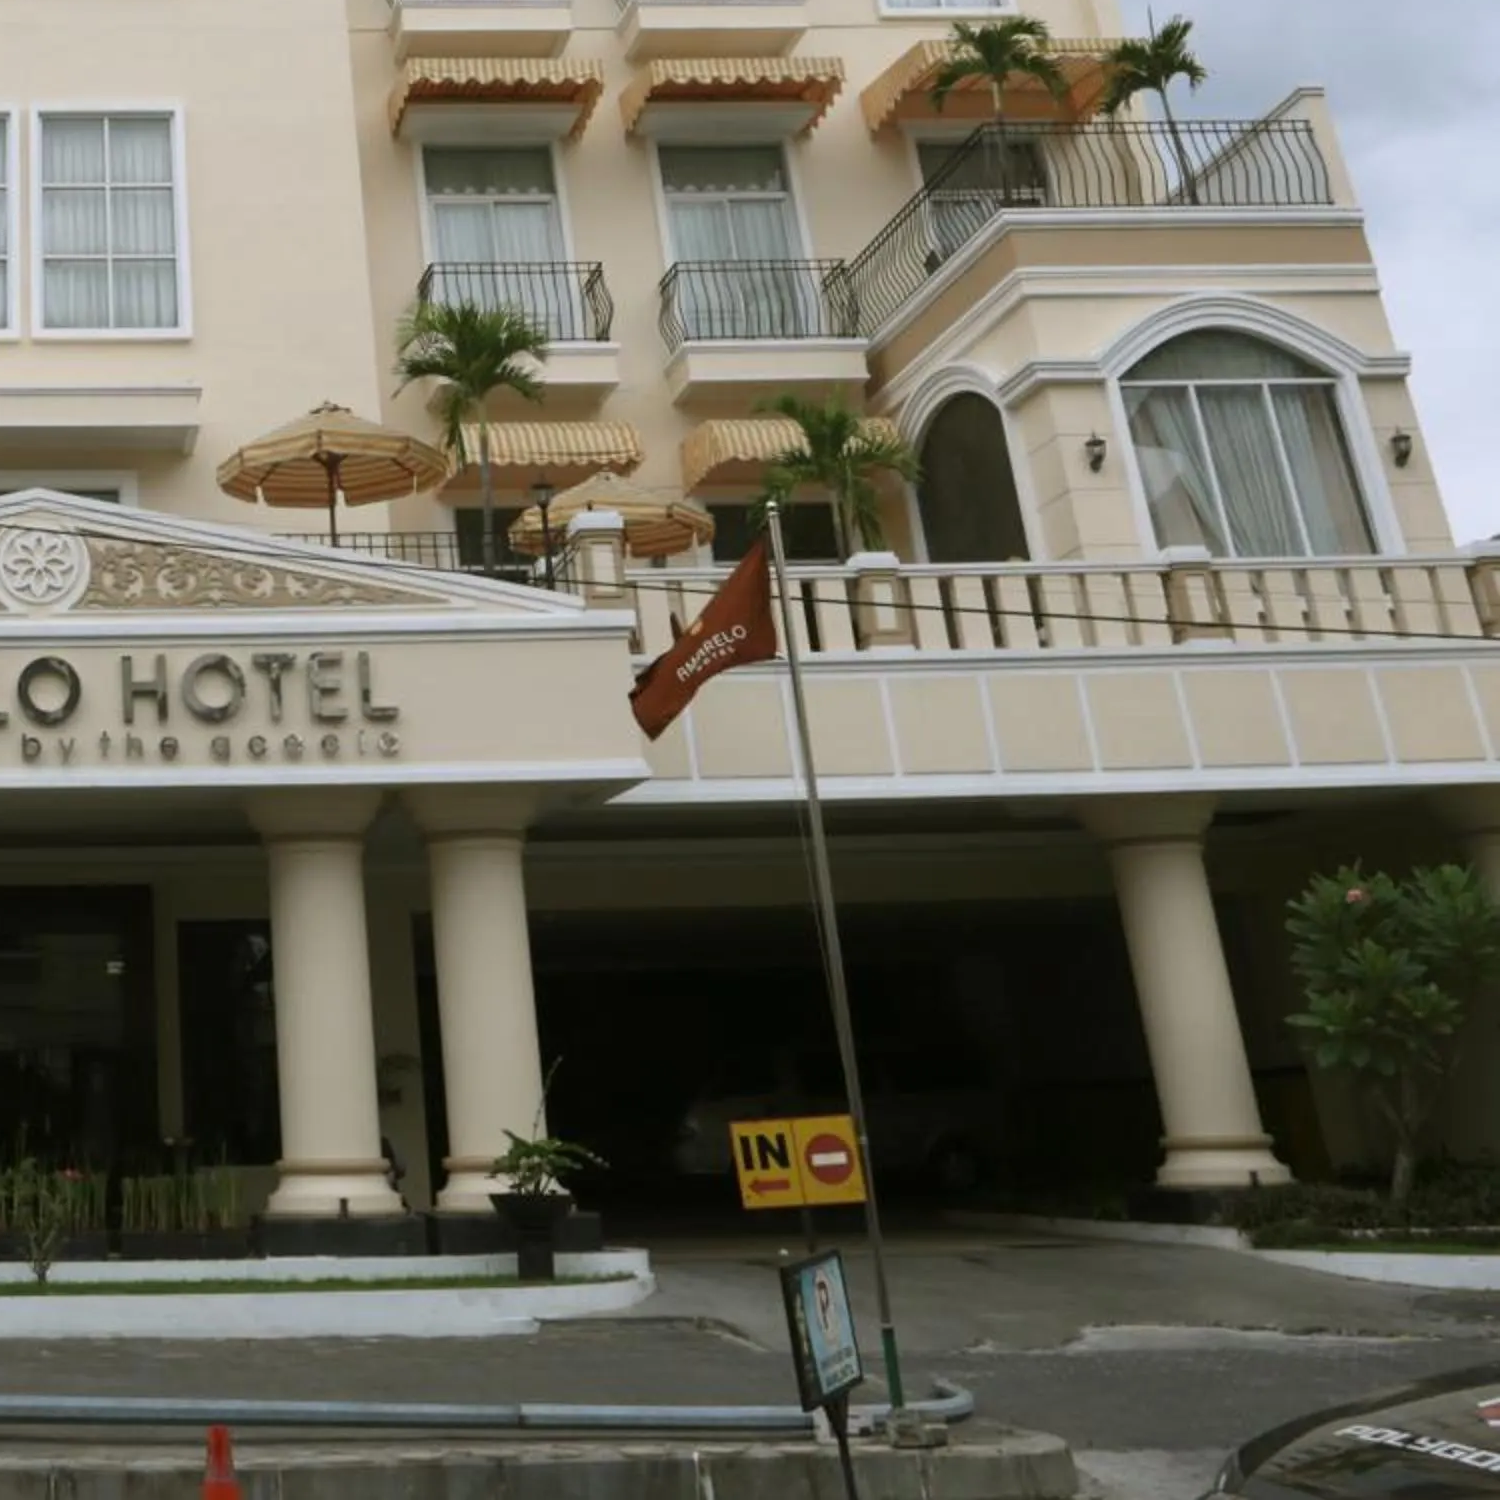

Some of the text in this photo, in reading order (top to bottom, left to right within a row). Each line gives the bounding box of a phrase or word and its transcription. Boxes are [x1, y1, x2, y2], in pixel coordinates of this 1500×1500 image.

[676, 624, 748, 682] AMARELO
[120, 650, 401, 728] HOTEL
[20, 732, 76, 766] by
[99, 730, 181, 762] the
[739, 1132, 790, 1171] IN
[1333, 1424, 1500, 1472] POLYGO
